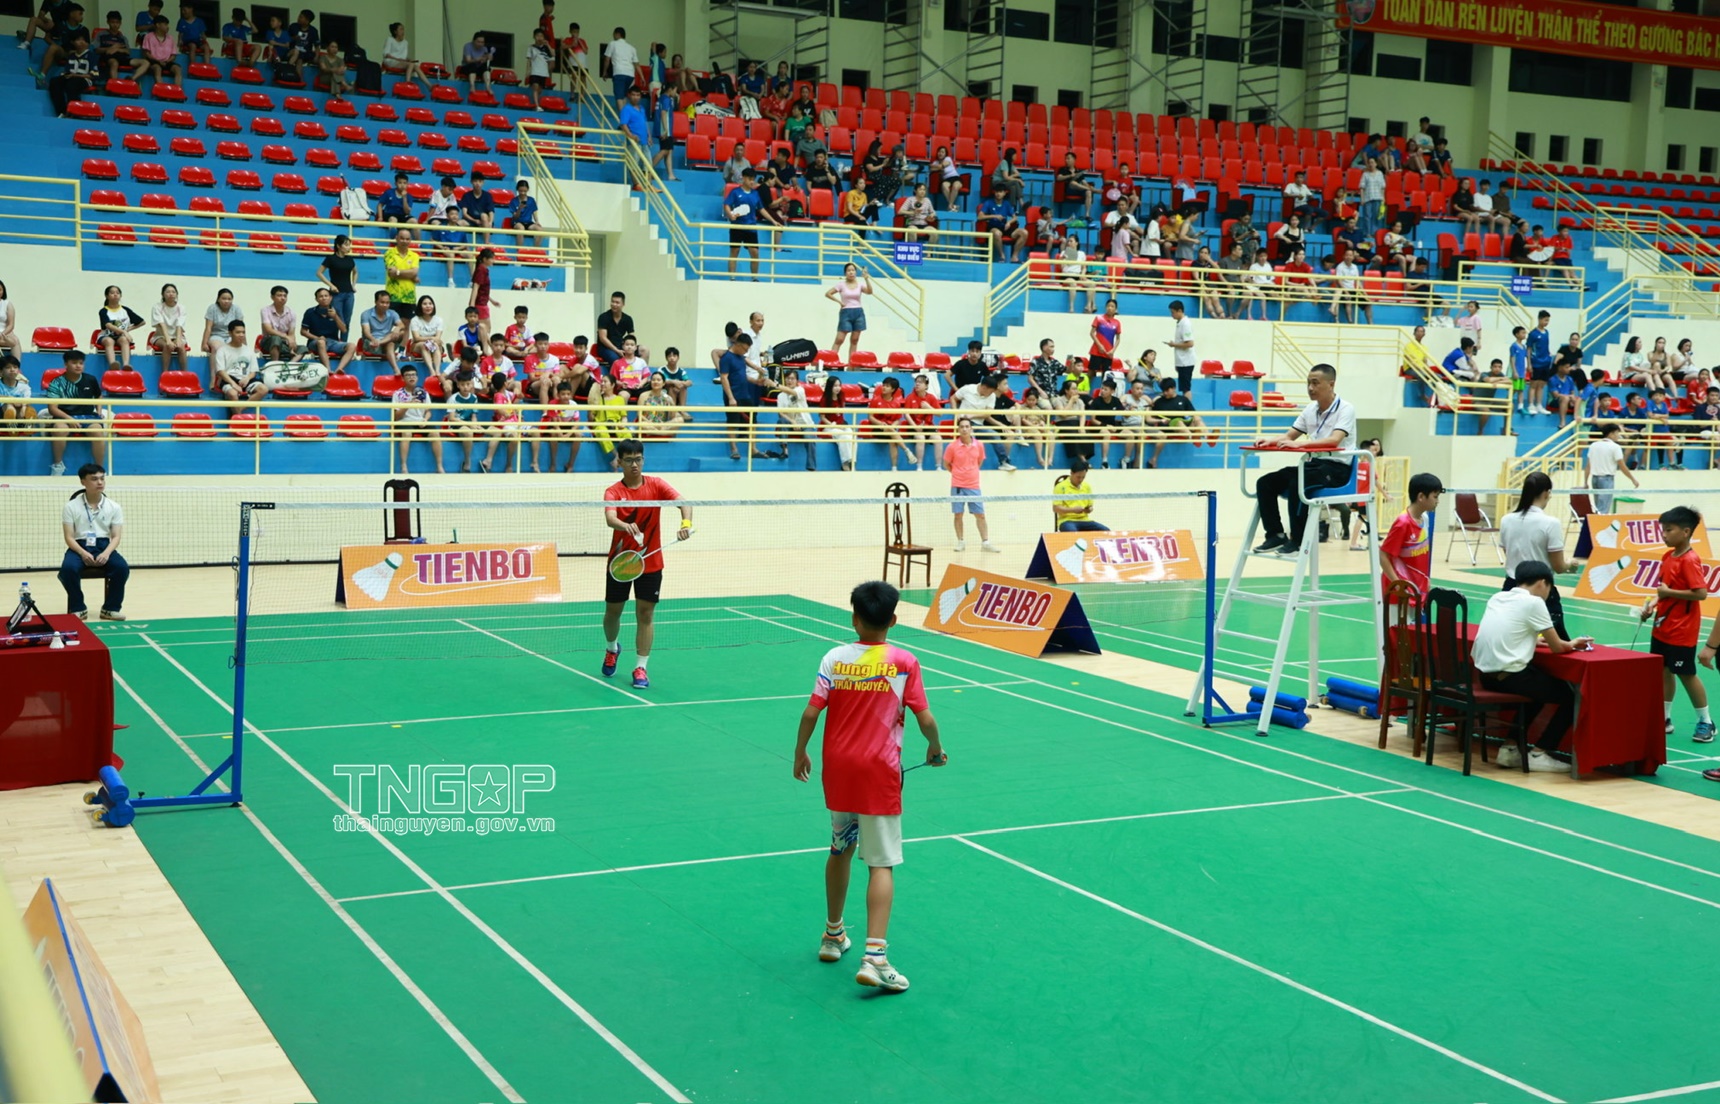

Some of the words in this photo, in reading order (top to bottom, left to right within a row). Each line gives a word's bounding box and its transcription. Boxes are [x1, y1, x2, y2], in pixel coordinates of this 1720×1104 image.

[1490, 5, 1534, 41] LUYỆN
[1538, 10, 1572, 42] THÂN
[1577, 10, 1603, 45] THỂ
[1604, 21, 1636, 48] THEO
[1639, 25, 1683, 54] GƯƠNG
[1686, 27, 1712, 57] BÁC
[413, 549, 532, 585] TIENBO
[972, 582, 1053, 627] TIENBO
[832, 661, 873, 678] Hưng
[875, 662, 898, 678] Hà
[834, 678, 852, 691] THÁI
[854, 680, 890, 692] NGUYÊN
